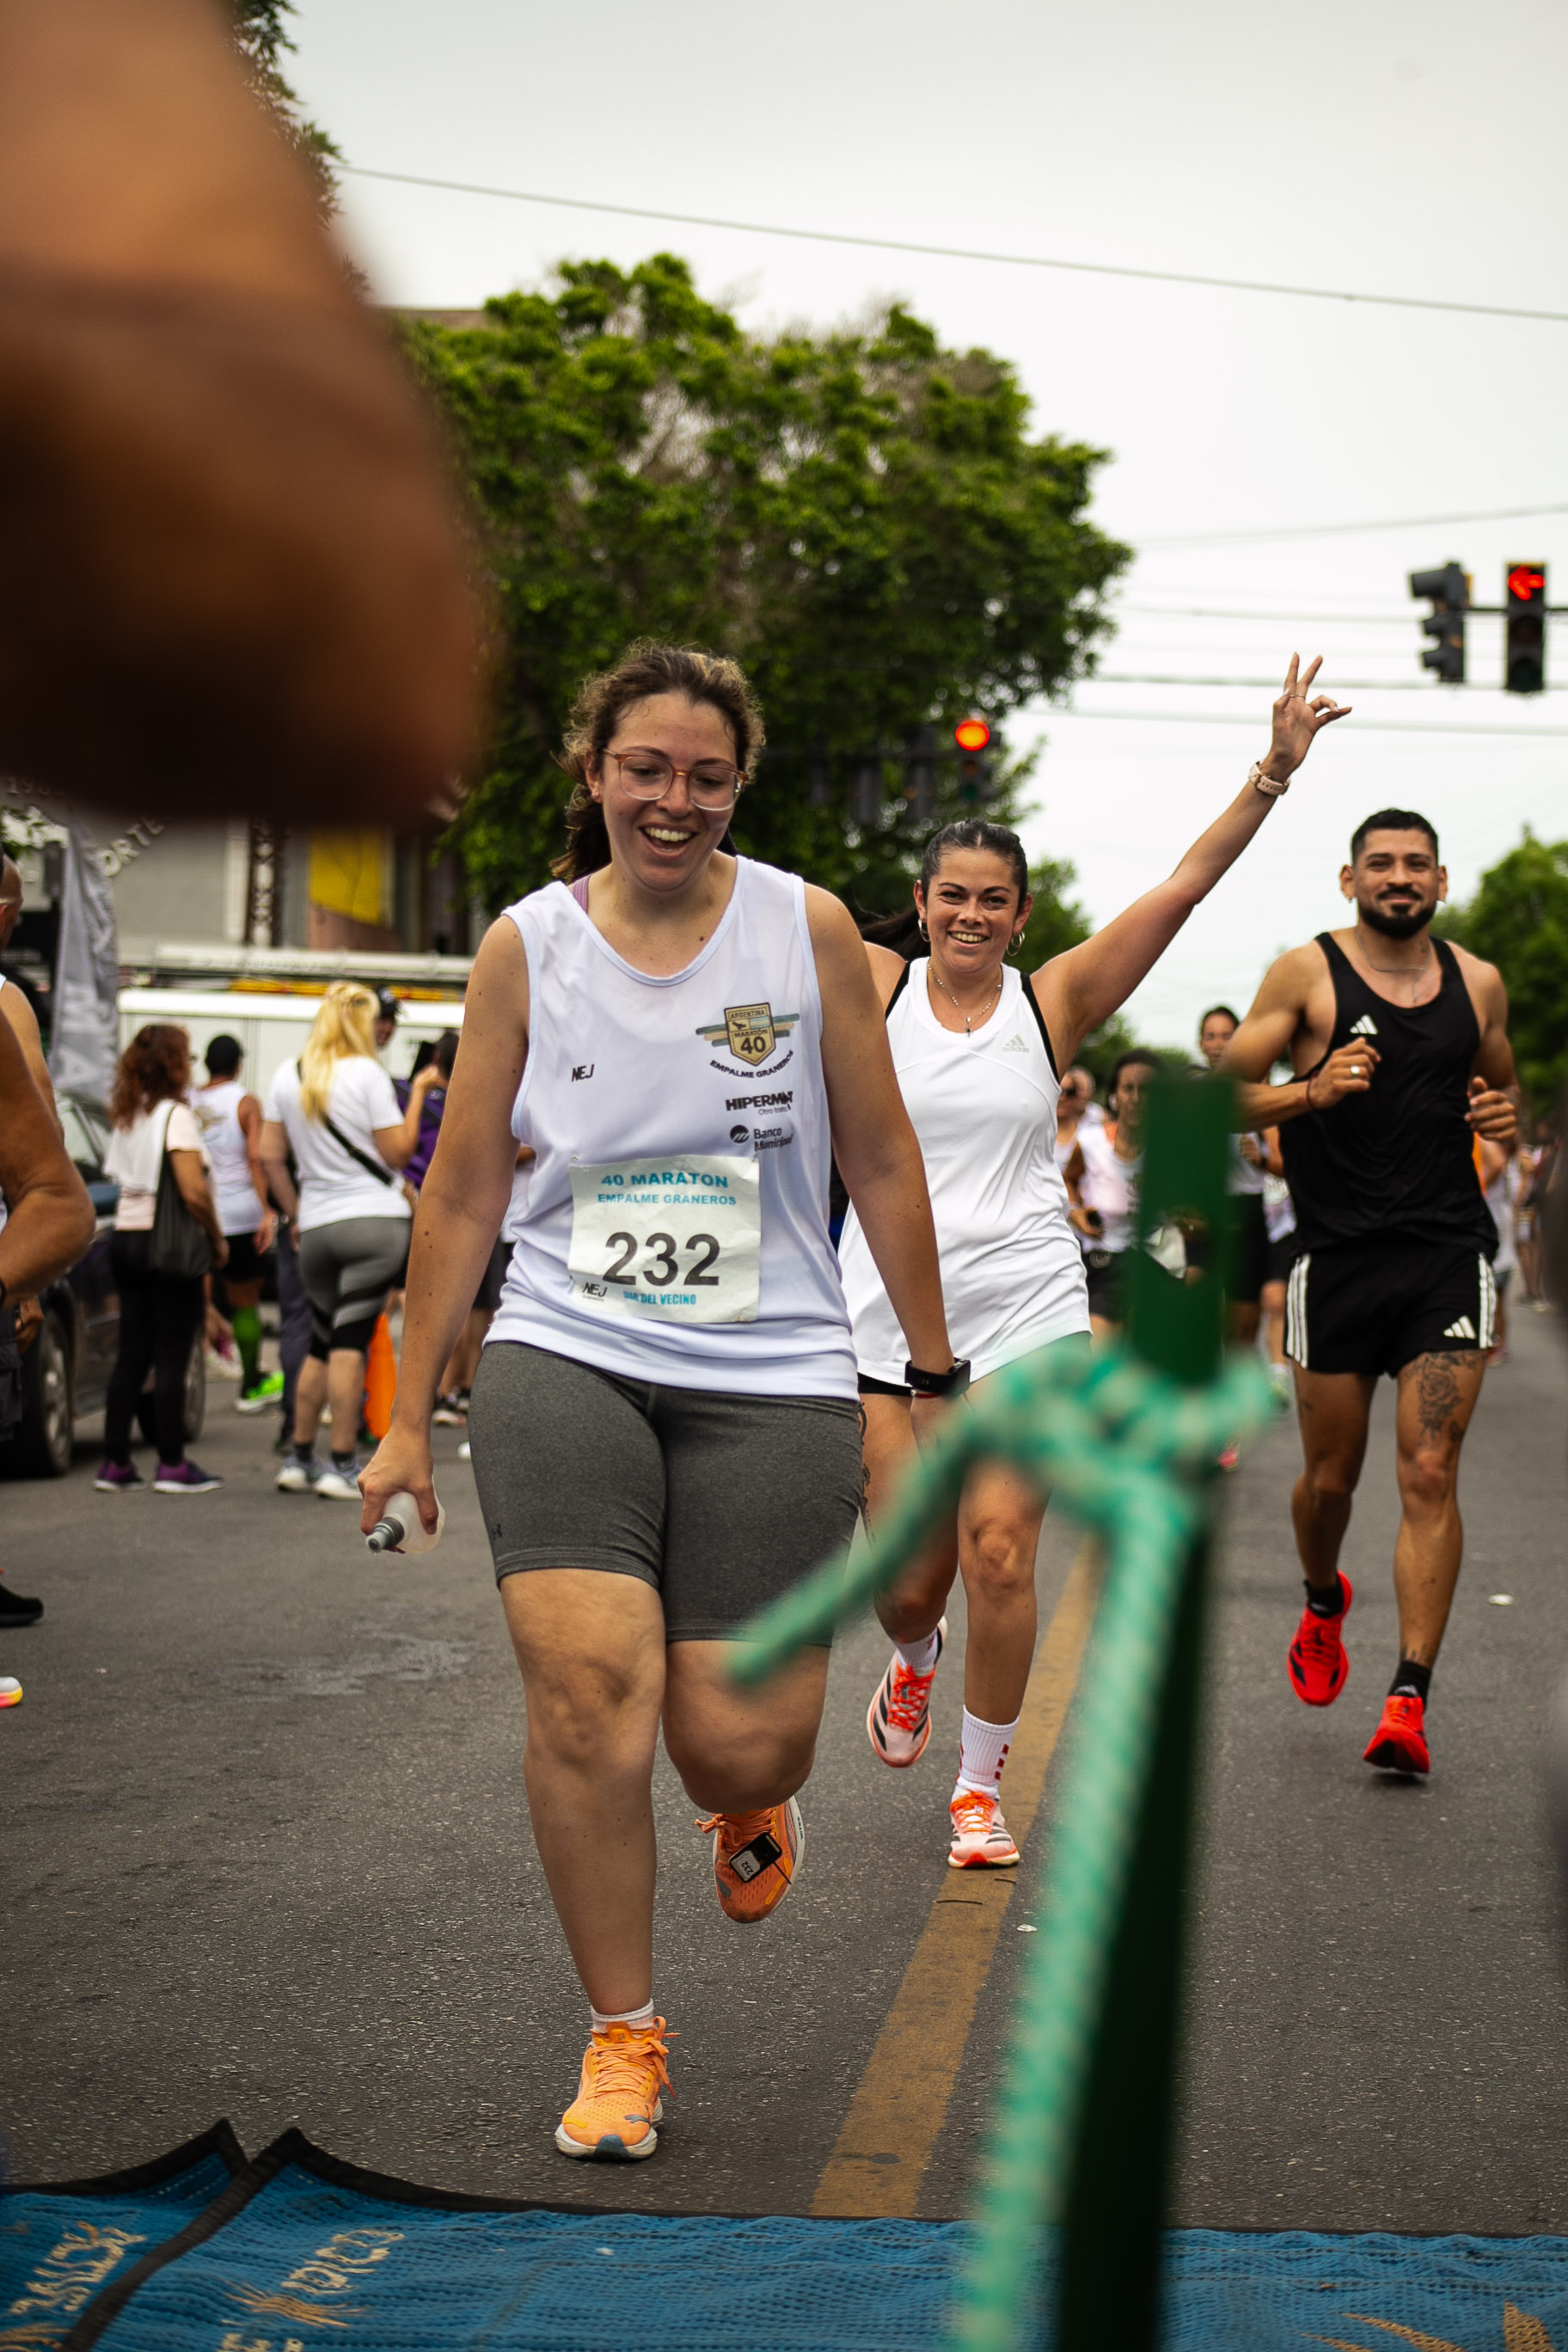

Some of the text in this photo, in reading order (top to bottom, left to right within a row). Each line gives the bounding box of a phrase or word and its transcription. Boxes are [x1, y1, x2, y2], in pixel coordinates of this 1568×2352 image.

[731, 1009, 765, 1020] ARGENTINA
[740, 1036, 767, 1054] 40
[571, 1063, 595, 1082] NEJ
[710, 1050, 793, 1078] EMPALME GRANEROS
[753, 1127, 782, 1140] Banco
[601, 1171, 729, 1189] 40 MARATON
[597, 1193, 737, 1205] EMPALME GRANEROS
[602, 1232, 720, 1286] 232
[583, 1282, 608, 1297] NEJ
[640, 1293, 658, 1305] DEL
[659, 1294, 697, 1305] VECINO
[740, 1859, 755, 1876] 232
